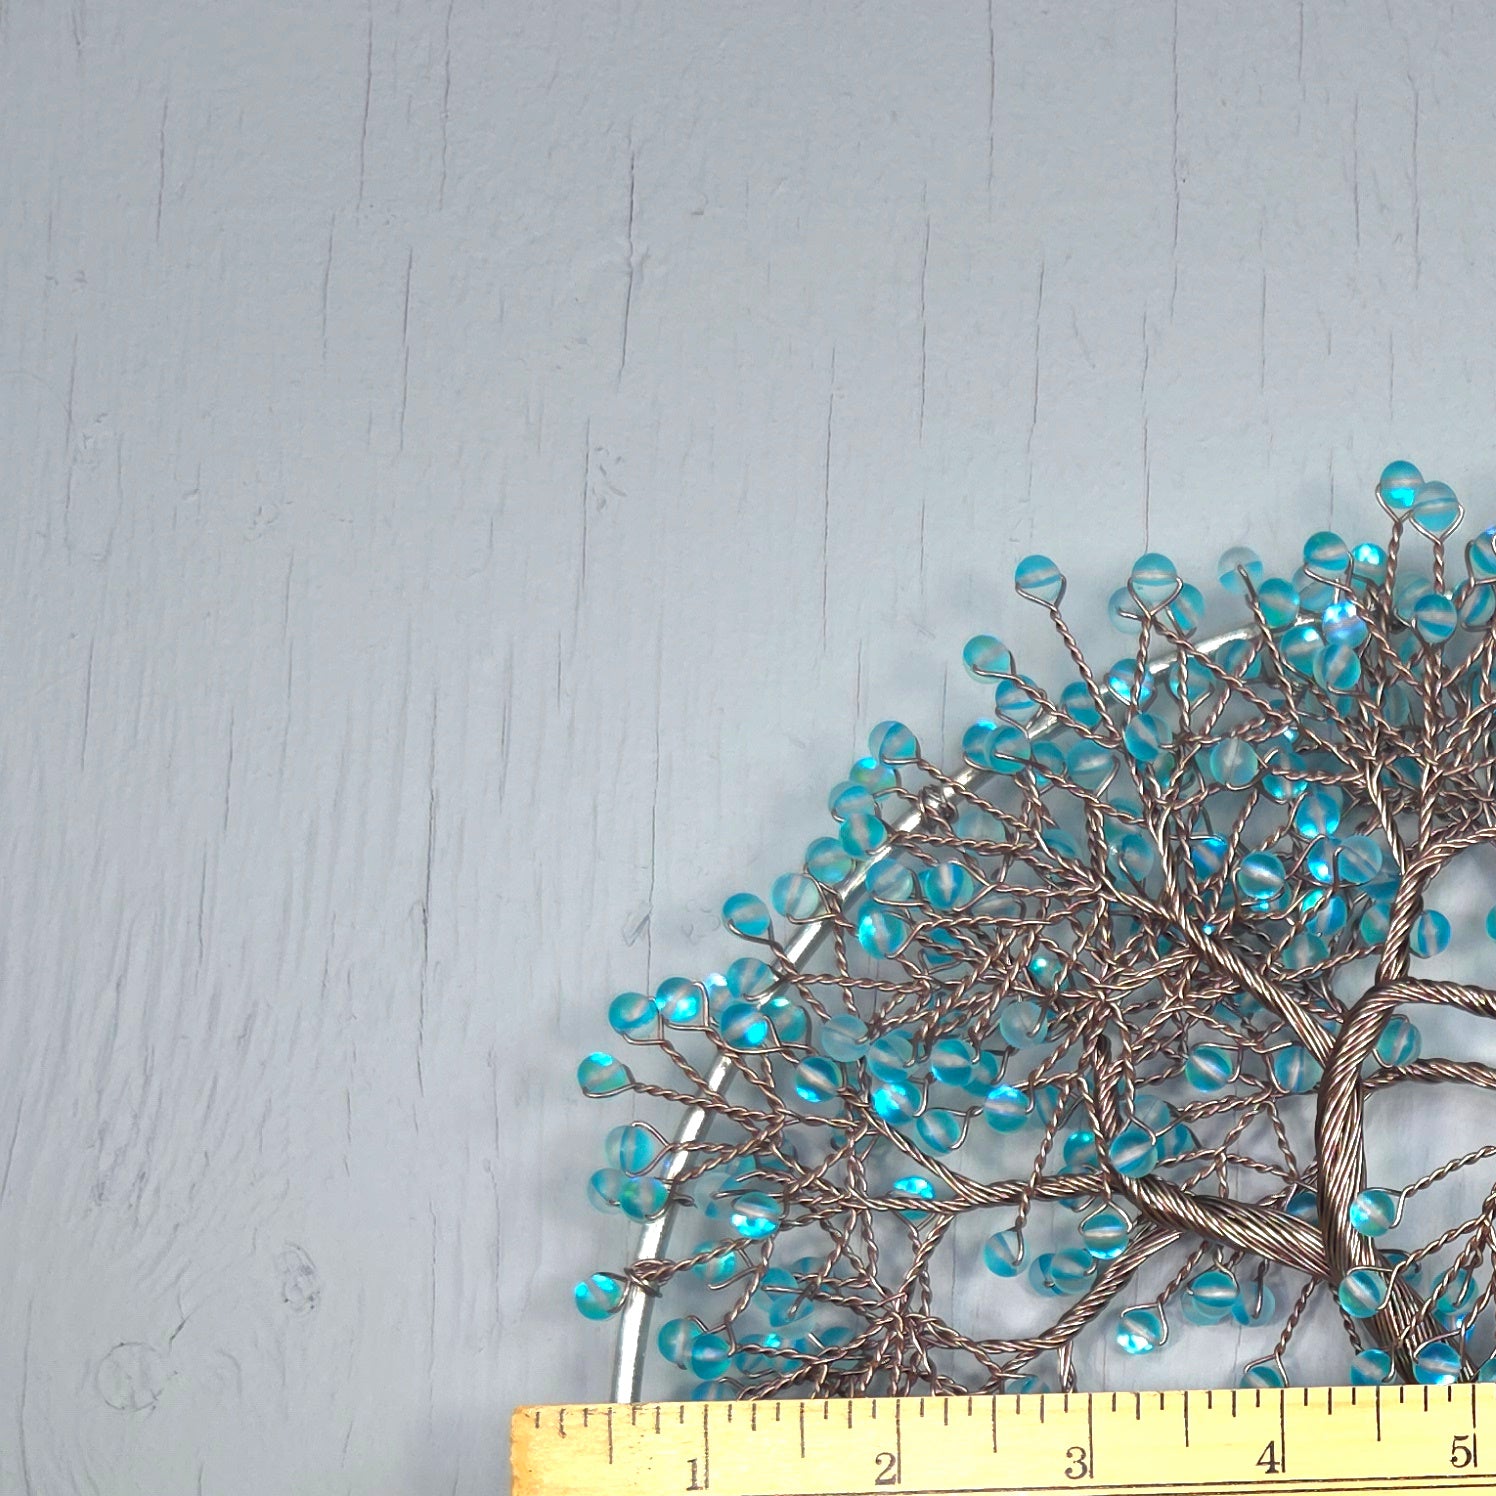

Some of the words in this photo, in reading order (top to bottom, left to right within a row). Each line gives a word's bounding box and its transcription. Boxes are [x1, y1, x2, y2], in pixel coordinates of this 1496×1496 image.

[1064, 1446, 1088, 1480] 3
[1255, 1440, 1280, 1474] 4
[1450, 1434, 1473, 1468] 5
[685, 1458, 704, 1491] 1
[874, 1452, 897, 1486] 2
